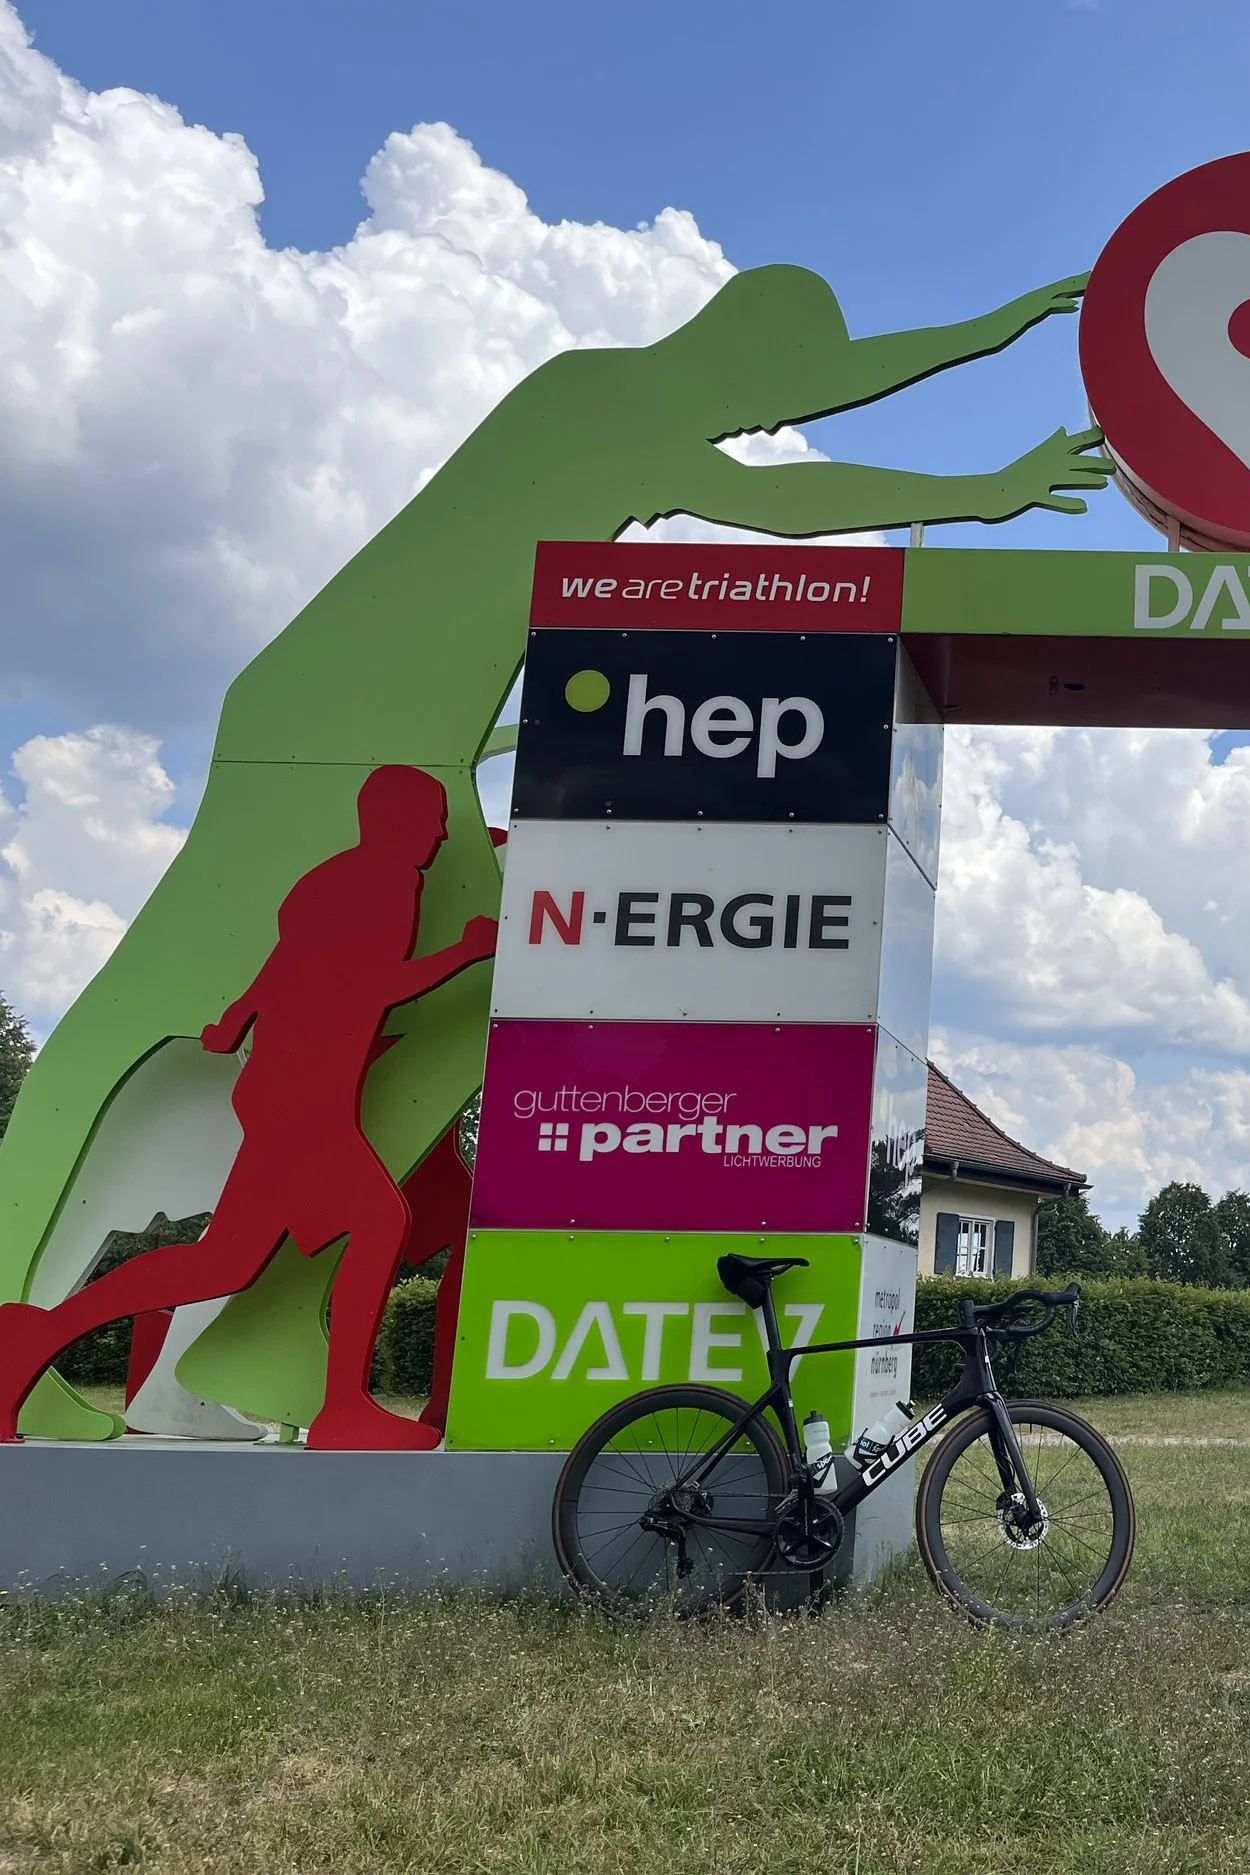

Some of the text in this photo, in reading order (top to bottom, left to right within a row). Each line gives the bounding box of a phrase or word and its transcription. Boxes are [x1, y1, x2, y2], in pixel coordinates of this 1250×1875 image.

[562, 572, 871, 603] we are triathlon!
[622, 673, 825, 779] hep
[513, 1085, 737, 1121] guttenberger
[578, 1115, 839, 1162] partner
[723, 1154, 822, 1168] LICHTWERBUNG
[874, 1287, 901, 1316] metropol
[870, 1350, 898, 1379] nürnberg
[861, 1402, 948, 1487] CUBE
